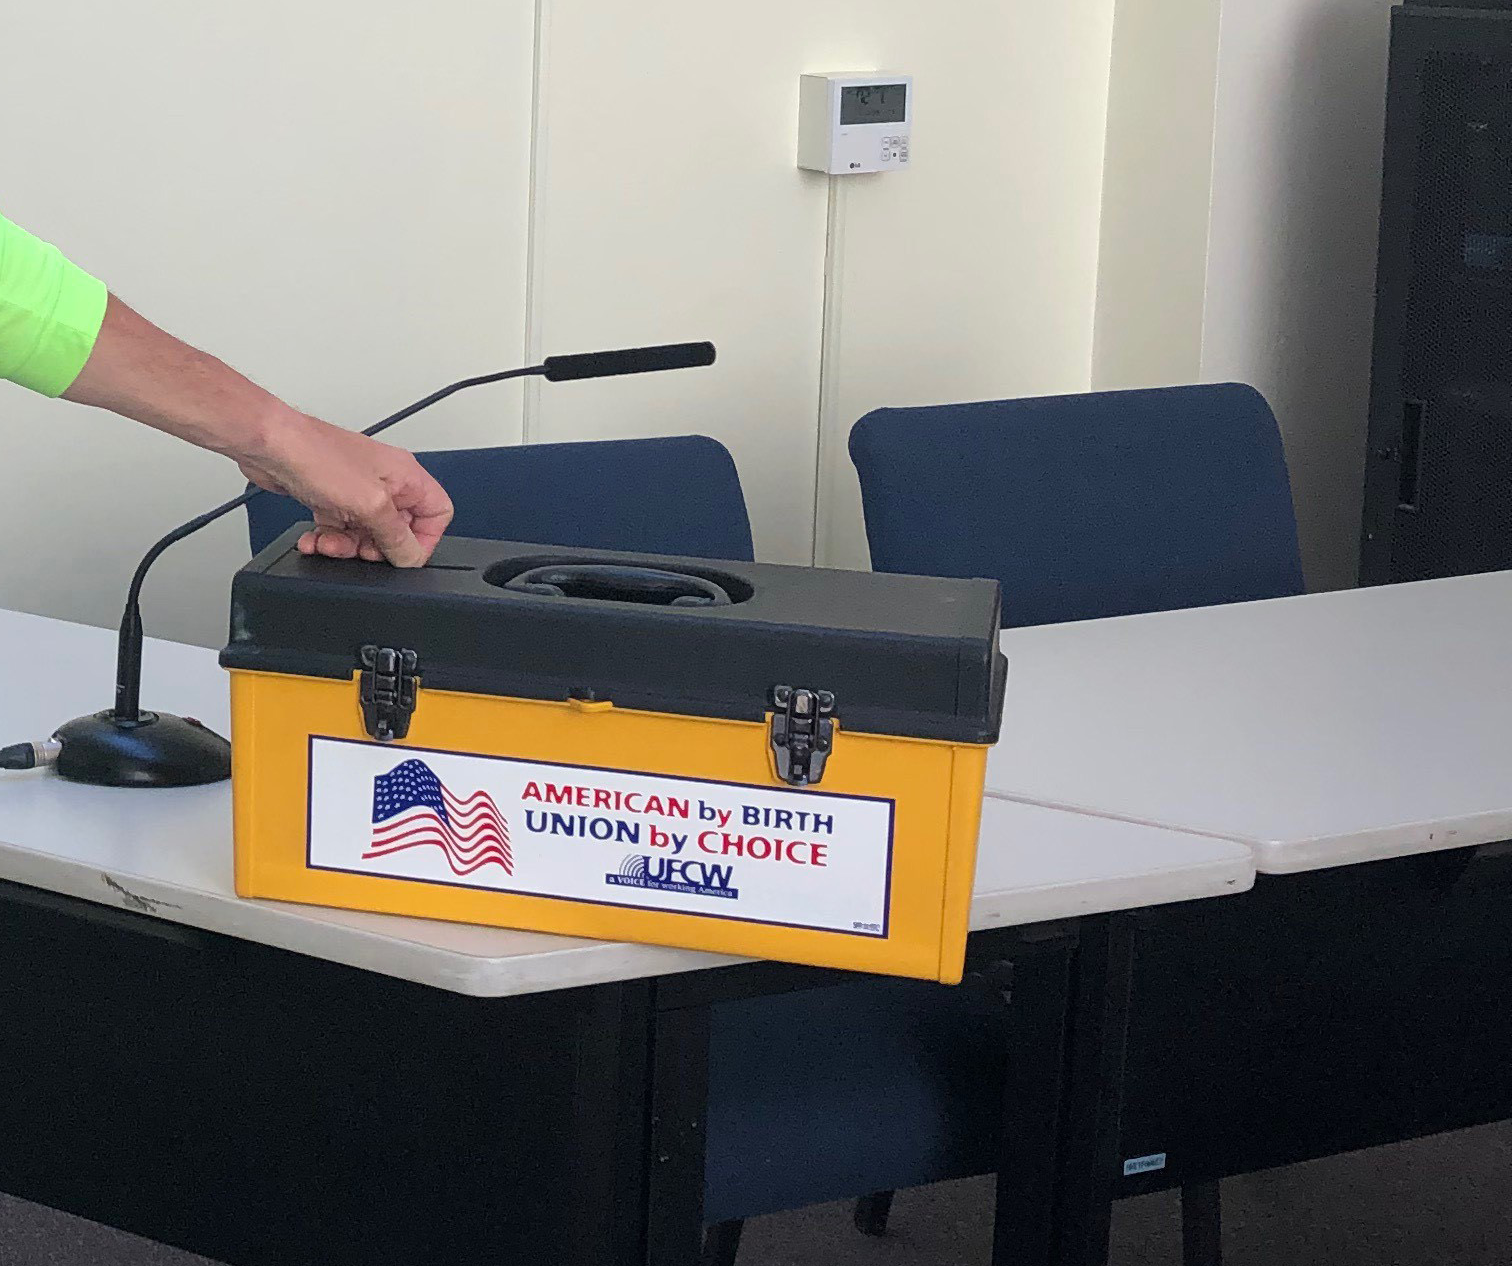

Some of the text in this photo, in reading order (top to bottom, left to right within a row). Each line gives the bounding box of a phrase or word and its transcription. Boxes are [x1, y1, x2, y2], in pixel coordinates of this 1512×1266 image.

[521, 781, 834, 835] AMERICAN by BIRTH
[524, 809, 828, 867] UNION by CHOICE
[617, 875, 645, 887] VOICE
[647, 879, 660, 889] for
[661, 882, 696, 893] working
[698, 886, 733, 897] America
[641, 855, 733, 889] UFCW
